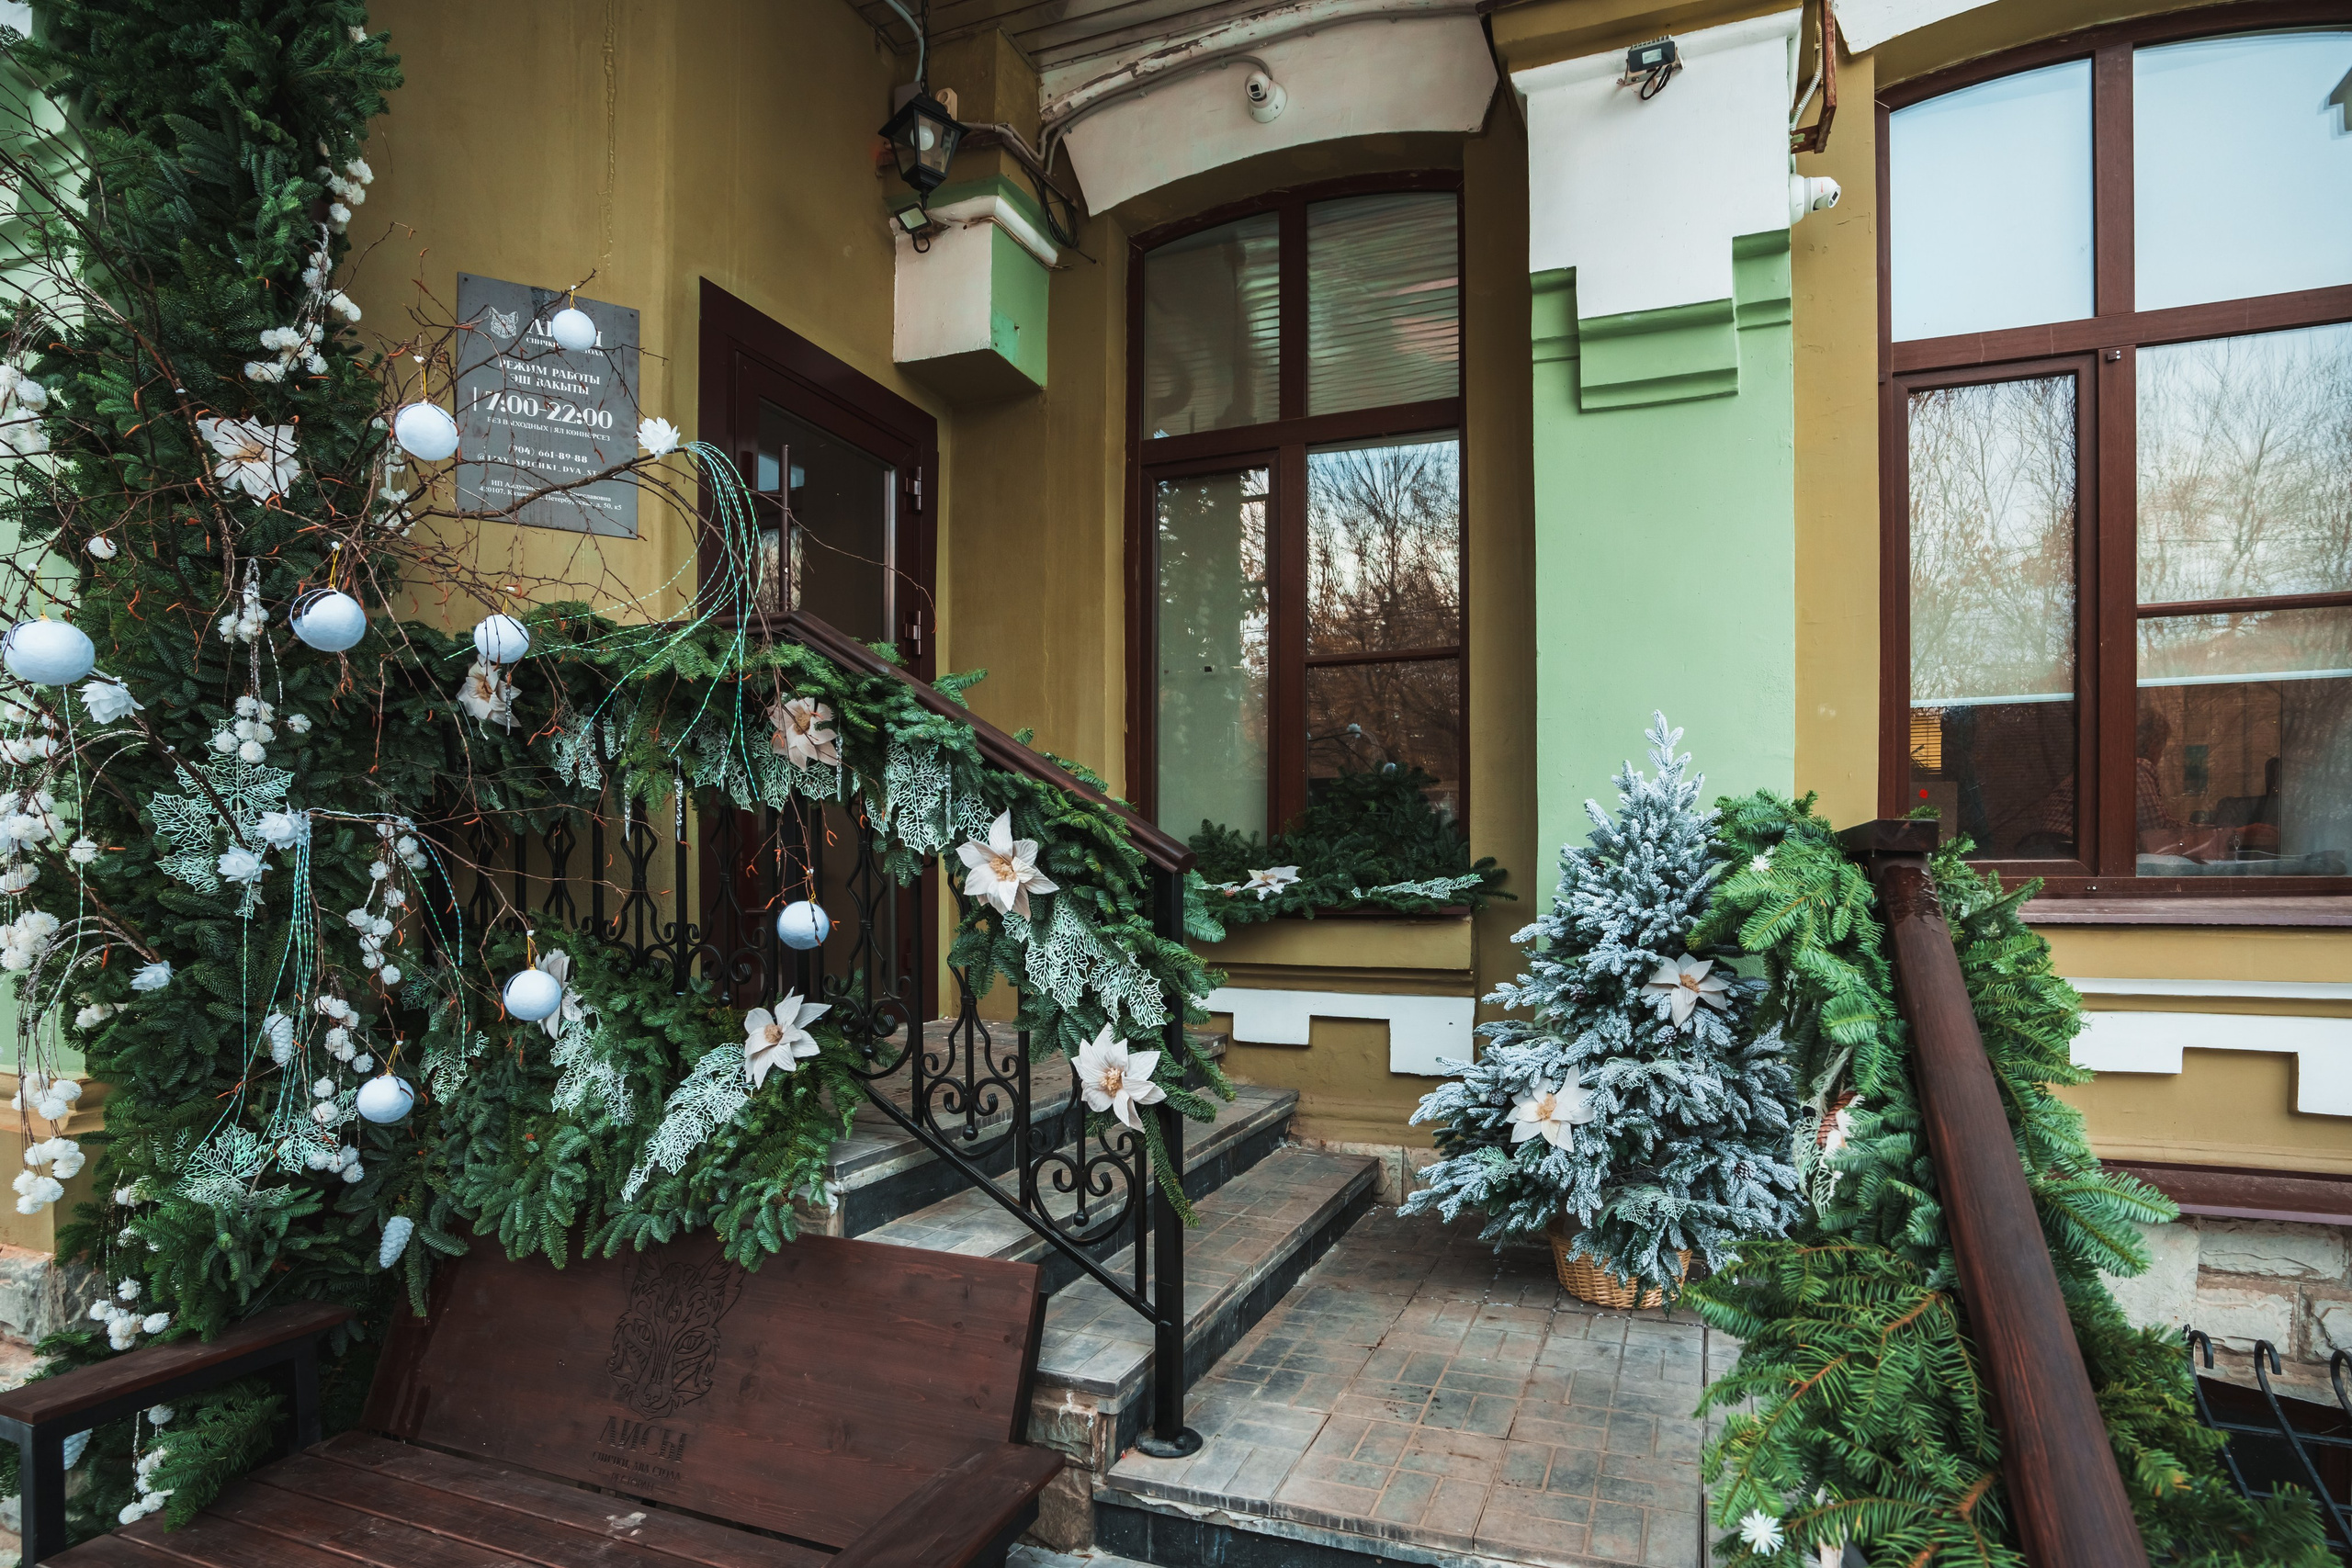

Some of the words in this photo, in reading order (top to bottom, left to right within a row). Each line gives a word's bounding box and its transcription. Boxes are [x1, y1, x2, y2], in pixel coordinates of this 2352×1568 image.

[499, 359, 548, 376] РЕЖИМ
[552, 368, 600, 385] РАБОТЫ
[509, 373, 531, 386] ЭШ
[536, 378, 589, 395] ВАКЫТЫ
[503, 419, 548, 432] ВЫХОДНЫХ
[508, 445, 535, 457] (904)
[538, 449, 588, 463] 661-89-88
[596, 1416, 689, 1463] ЛИСЫ
[611, 1472, 655, 1491] РЕСТОРАН
[652, 1466, 681, 1483] СТОЛА
